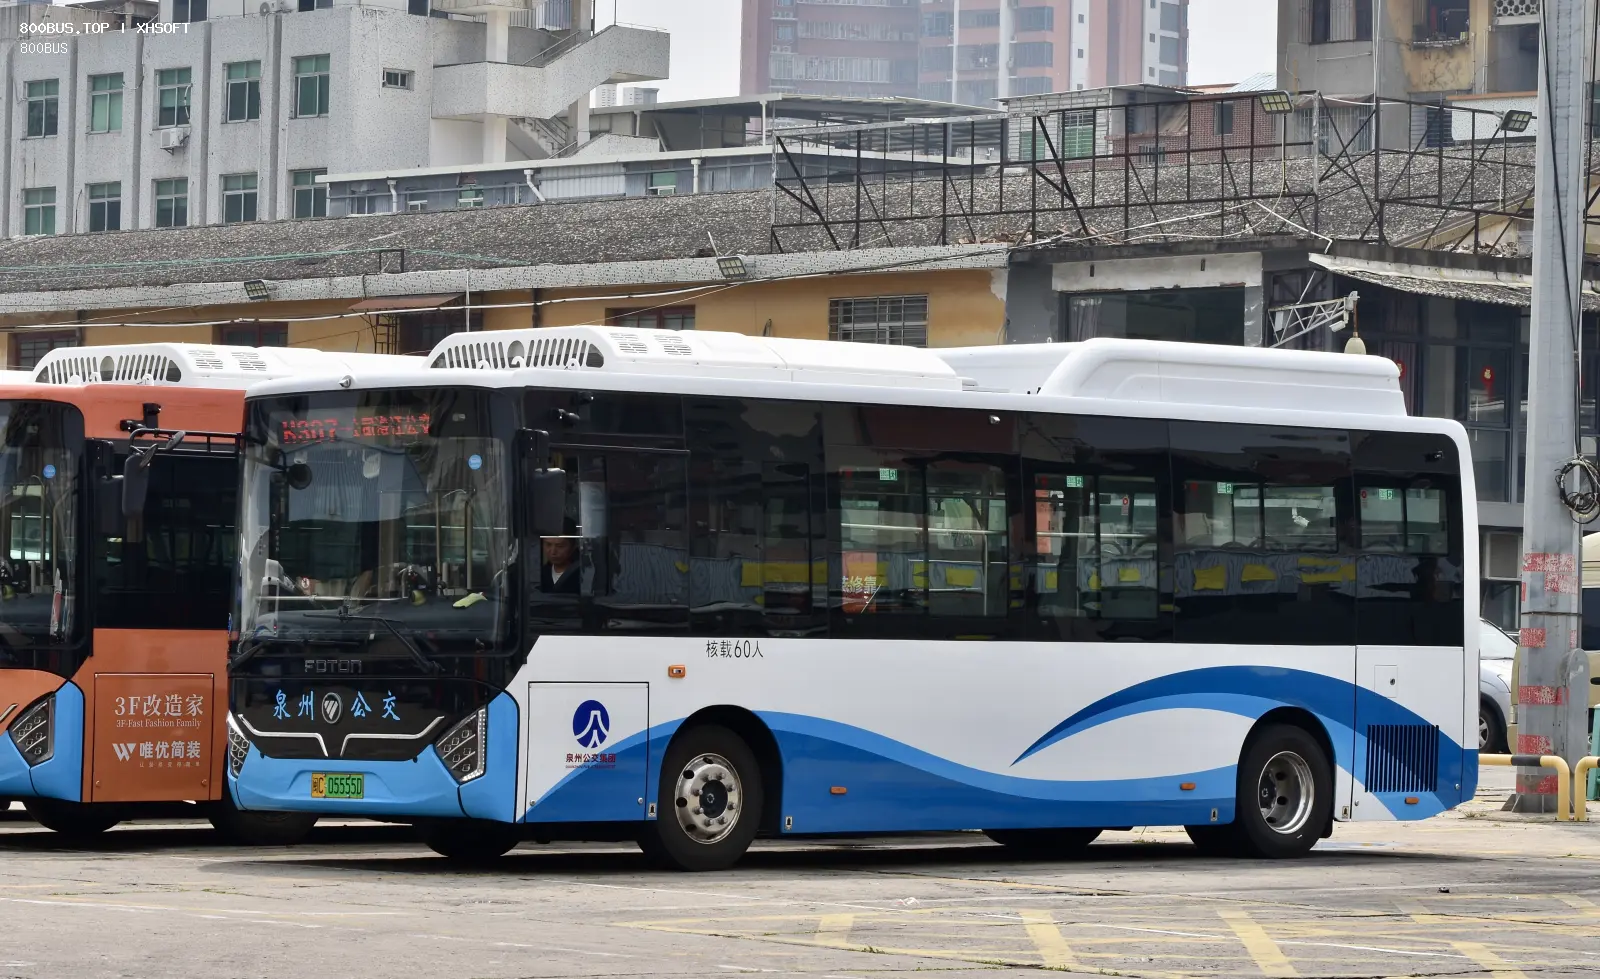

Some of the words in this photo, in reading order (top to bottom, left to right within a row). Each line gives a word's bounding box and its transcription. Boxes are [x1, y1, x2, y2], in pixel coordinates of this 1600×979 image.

[706, 639, 764, 658] 核载60人
[304, 659, 362, 673] FOTON
[114, 693, 204, 717] 3F改造家
[273, 689, 314, 720] 泉州
[350, 690, 401, 721] 公交
[145, 718, 175, 728] Fashion
[176, 718, 202, 730] Family
[139, 740, 201, 759] 唯优简装
[565, 752, 617, 763] 泉州公交集团
